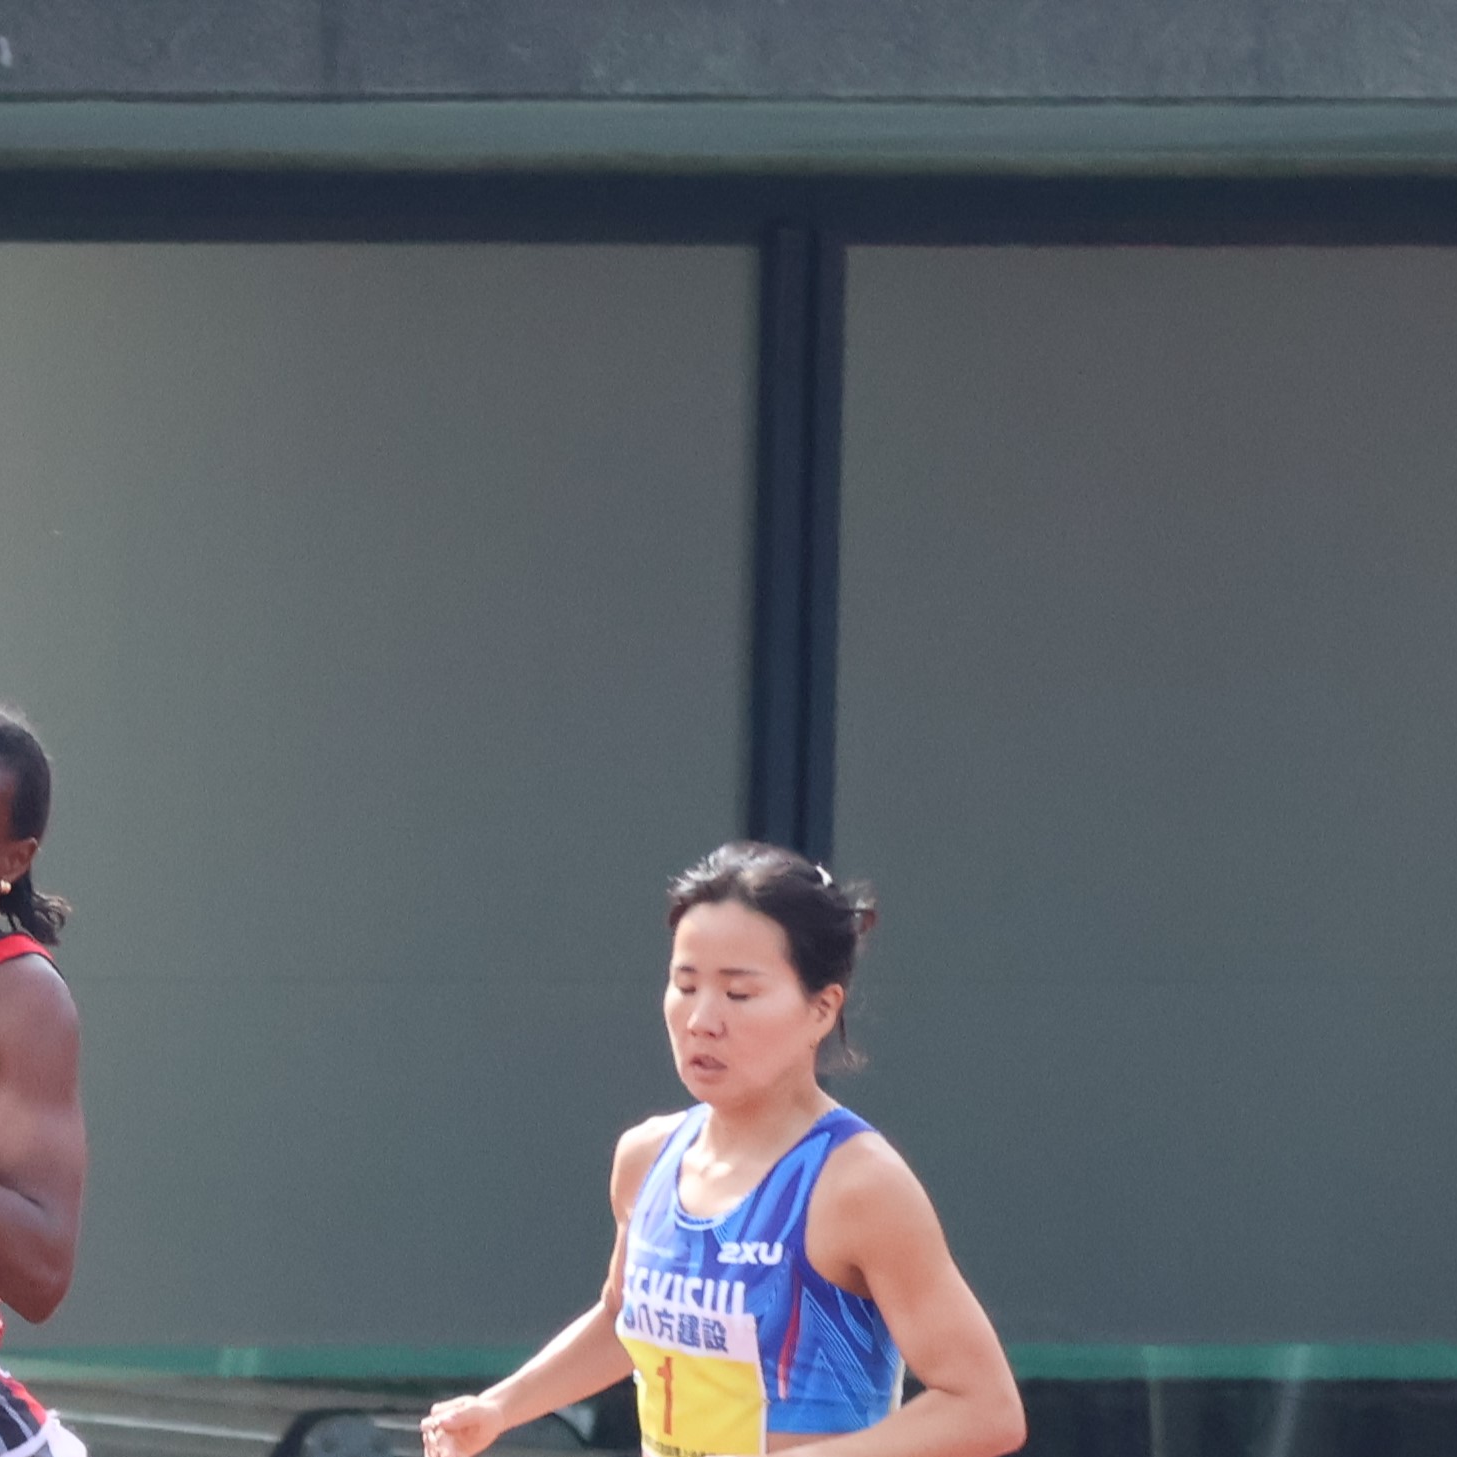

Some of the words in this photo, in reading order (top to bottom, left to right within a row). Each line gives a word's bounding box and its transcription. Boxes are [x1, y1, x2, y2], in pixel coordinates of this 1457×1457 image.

[717, 1241, 784, 1265] 2XU
[637, 1303, 729, 1353] 八方建設
[656, 1356, 674, 1436] 1
